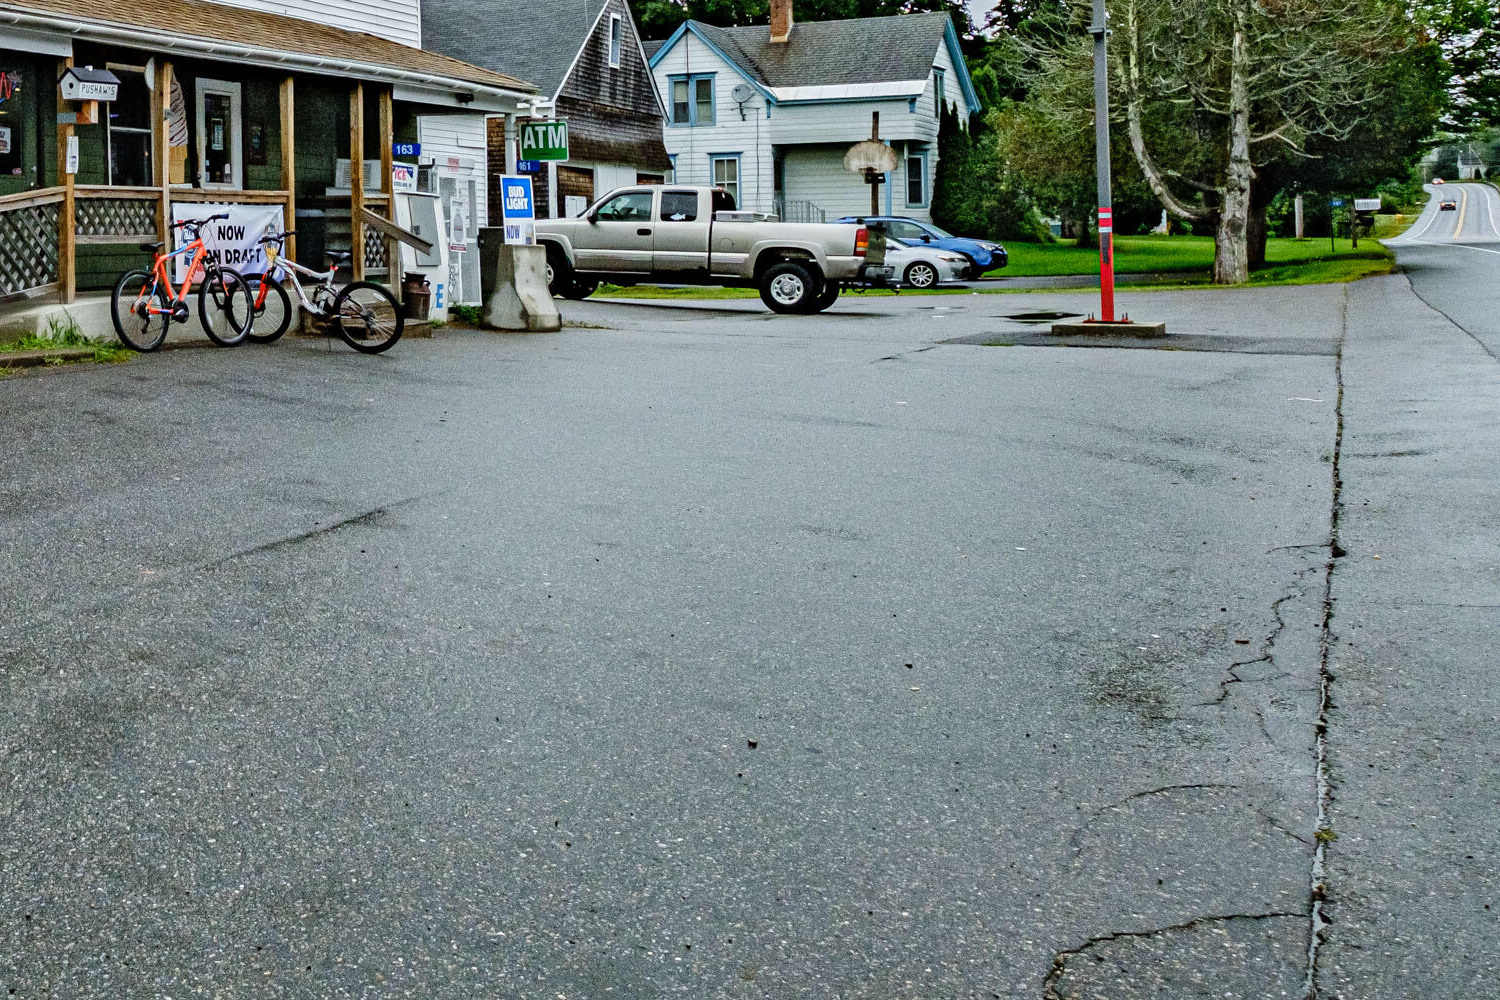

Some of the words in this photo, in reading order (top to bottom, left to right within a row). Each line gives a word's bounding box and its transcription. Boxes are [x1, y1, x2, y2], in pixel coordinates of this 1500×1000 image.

[81, 83, 116, 96] PUSHAW'S
[523, 125, 566, 150] ATM
[396, 145, 413, 155] 163
[394, 168, 407, 180] ICE
[508, 186, 525, 198] BUD
[506, 198, 529, 210] LIGHT
[218, 226, 246, 240] NOW
[506, 225, 521, 240] NOW
[206, 249, 221, 264] ON
[225, 249, 262, 265] DRAFT
